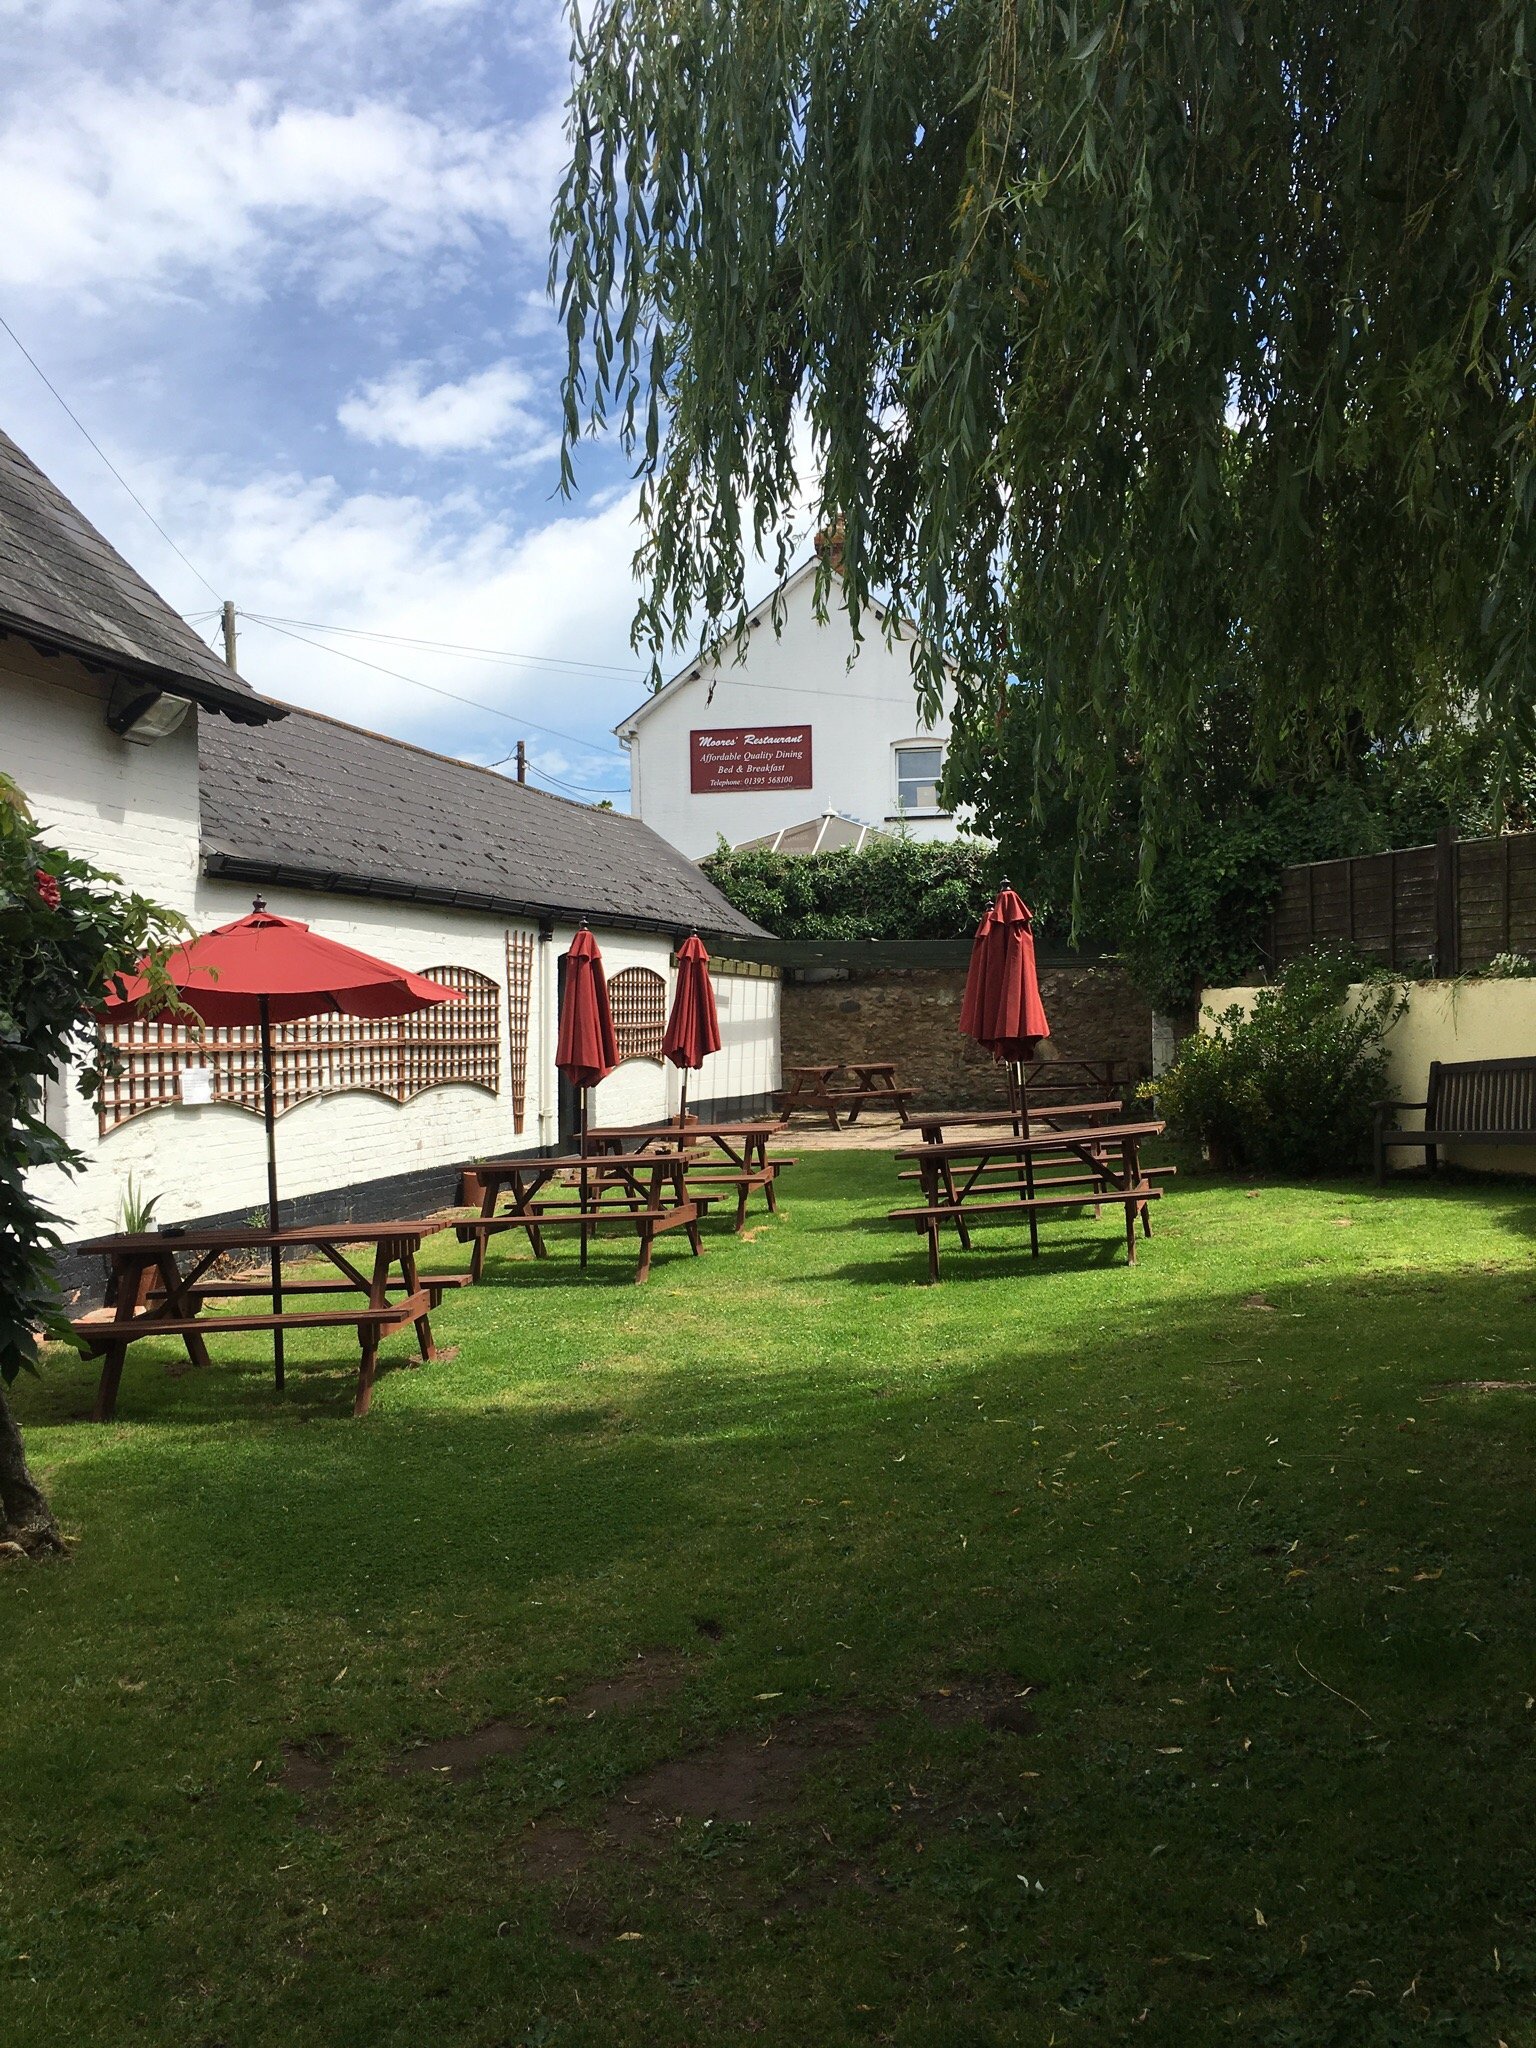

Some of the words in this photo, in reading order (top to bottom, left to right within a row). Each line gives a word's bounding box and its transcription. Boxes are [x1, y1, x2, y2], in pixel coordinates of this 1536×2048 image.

[744, 734, 802, 746] Restaurant
[700, 753, 741, 763] Affordable
[744, 752, 773, 762] Quality
[776, 750, 803, 760] Dining
[718, 765, 733, 774] Bed
[747, 764, 785, 773] Breakfast
[744, 777, 765, 785] 01395
[768, 776, 793, 784] 568100
